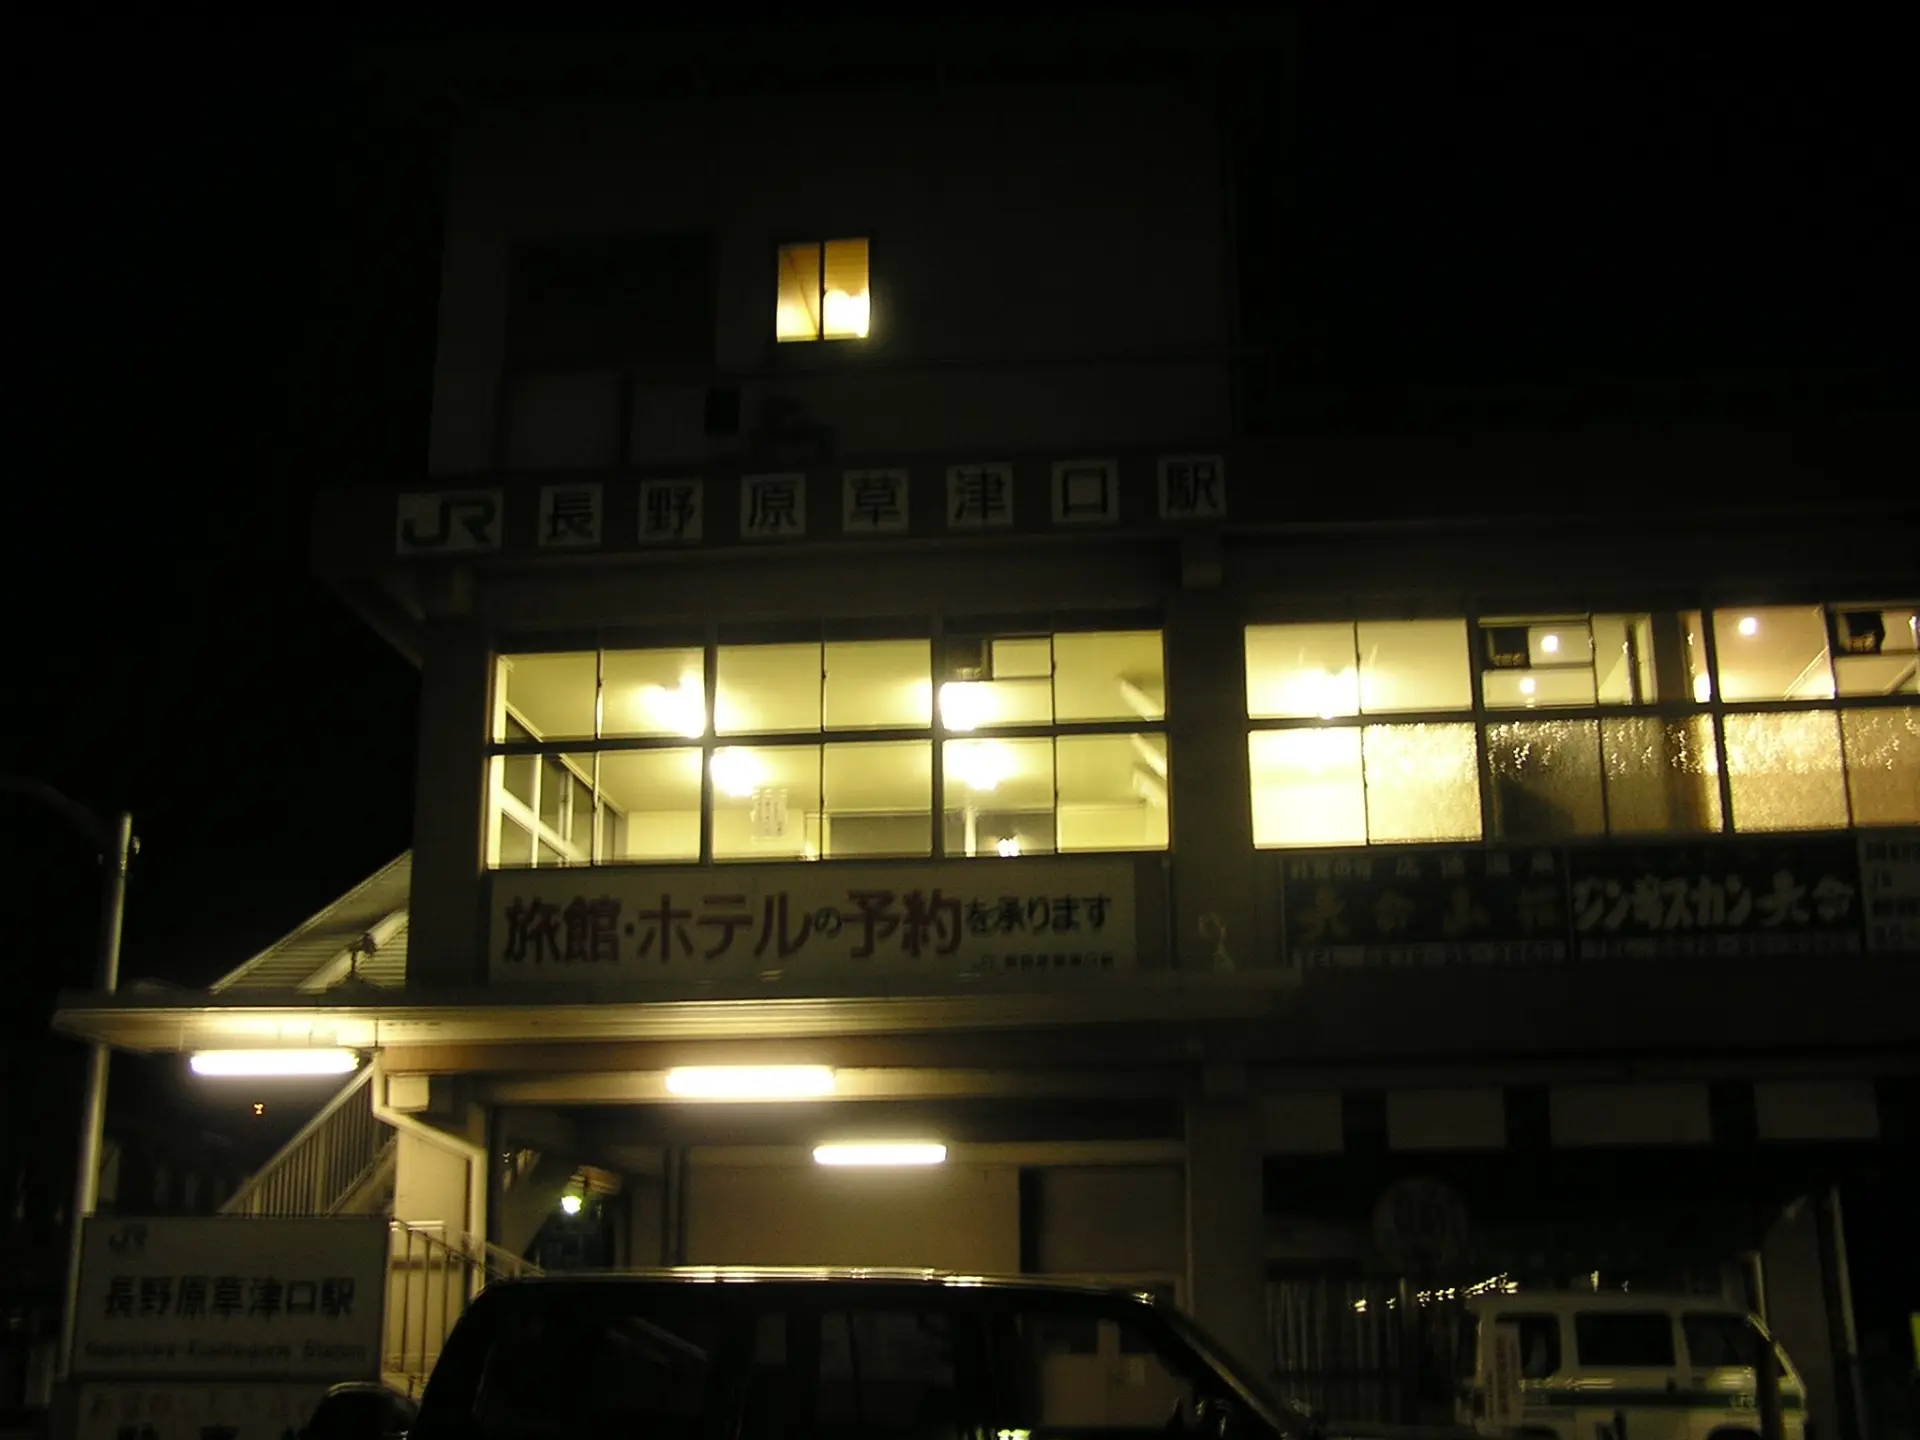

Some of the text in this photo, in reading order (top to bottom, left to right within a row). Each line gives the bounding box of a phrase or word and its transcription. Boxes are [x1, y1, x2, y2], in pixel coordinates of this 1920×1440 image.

[402, 459, 1222, 546] JR 長野原草津口駅
[107, 1223, 148, 1250] JR
[104, 1274, 356, 1320] 長野原草津口駅
